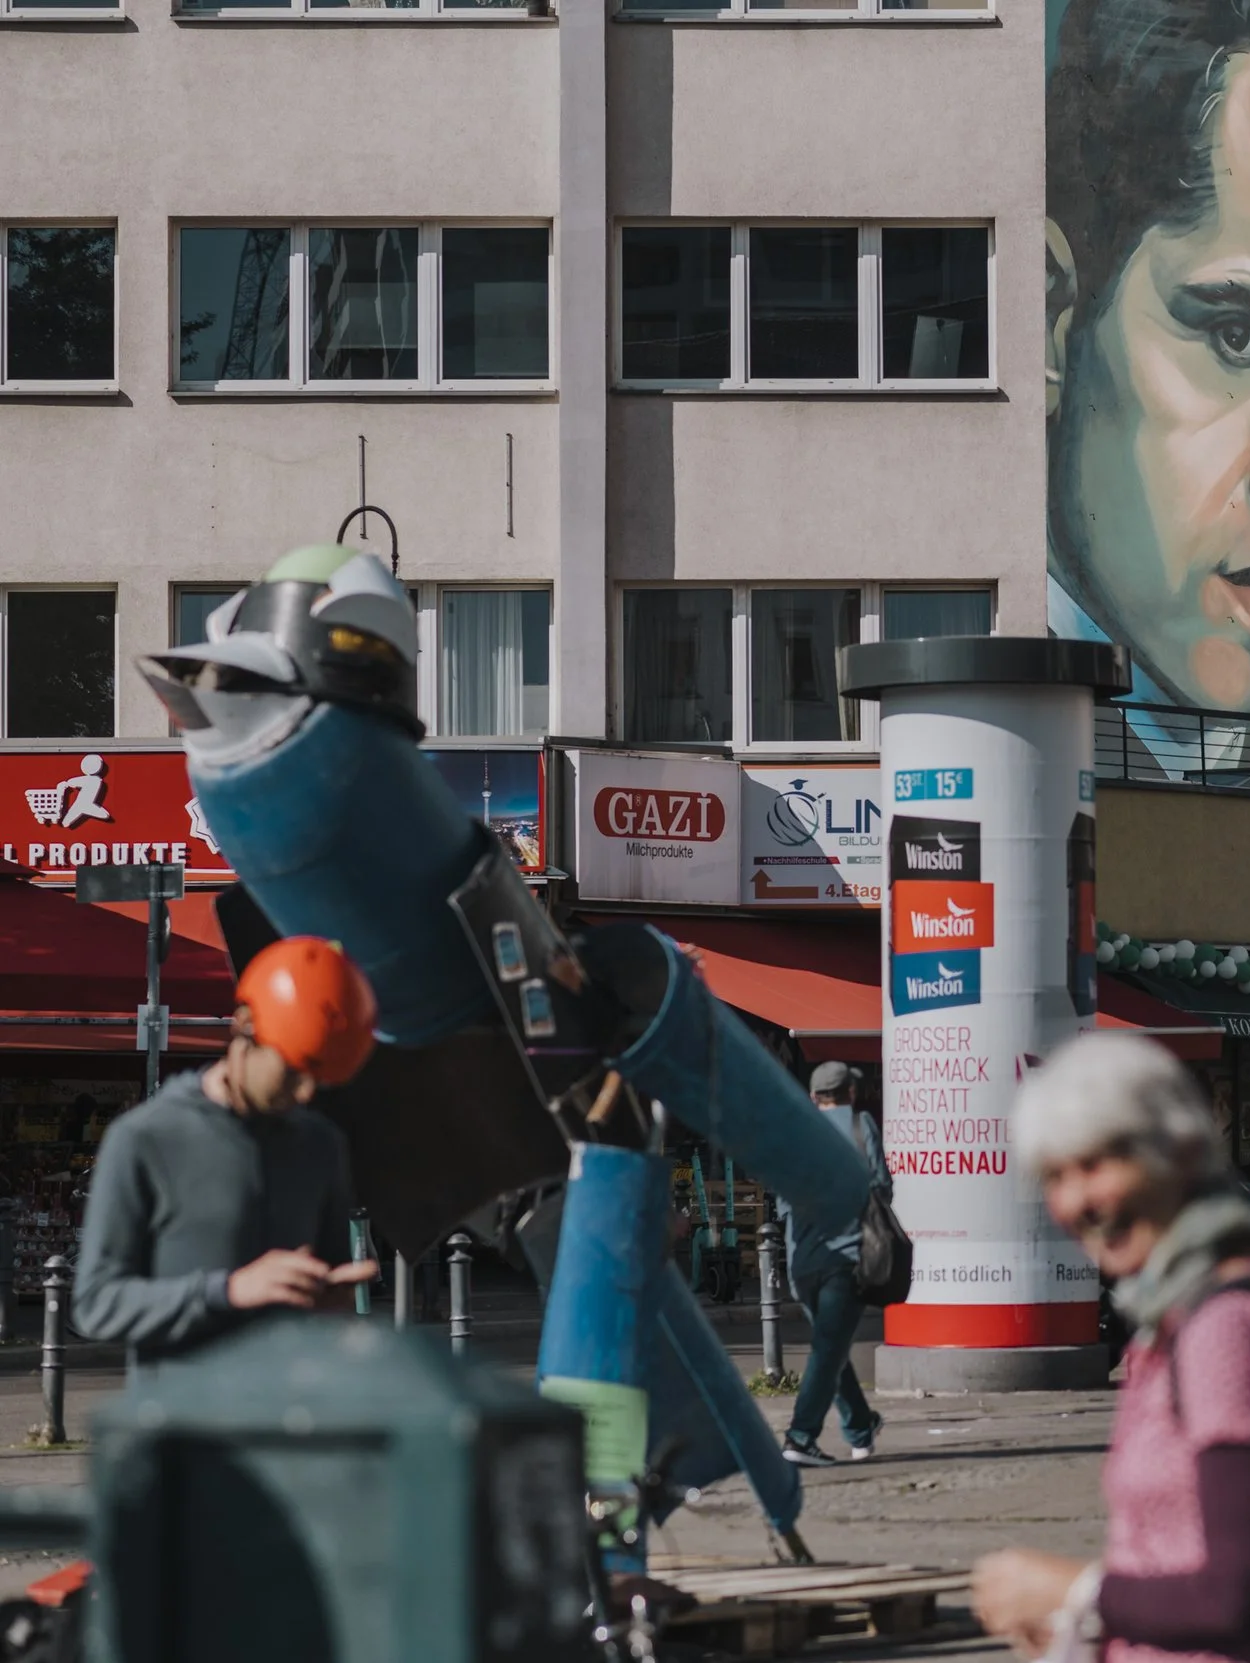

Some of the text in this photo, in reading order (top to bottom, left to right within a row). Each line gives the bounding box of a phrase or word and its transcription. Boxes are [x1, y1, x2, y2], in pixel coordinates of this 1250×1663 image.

[29, 842, 187, 867] PRODUKTE
[626, 842, 694, 859] Milchprodukte
[905, 842, 963, 871] Winston
[911, 911, 974, 939] Winston
[907, 977, 963, 1000] Winston
[894, 1026, 971, 1053] GROSSER
[889, 1056, 990, 1083] GESCHMACK
[898, 1087, 971, 1113] ANSTATT
[928, 1265, 947, 1282] ist
[952, 1265, 1012, 1282] tödlich
